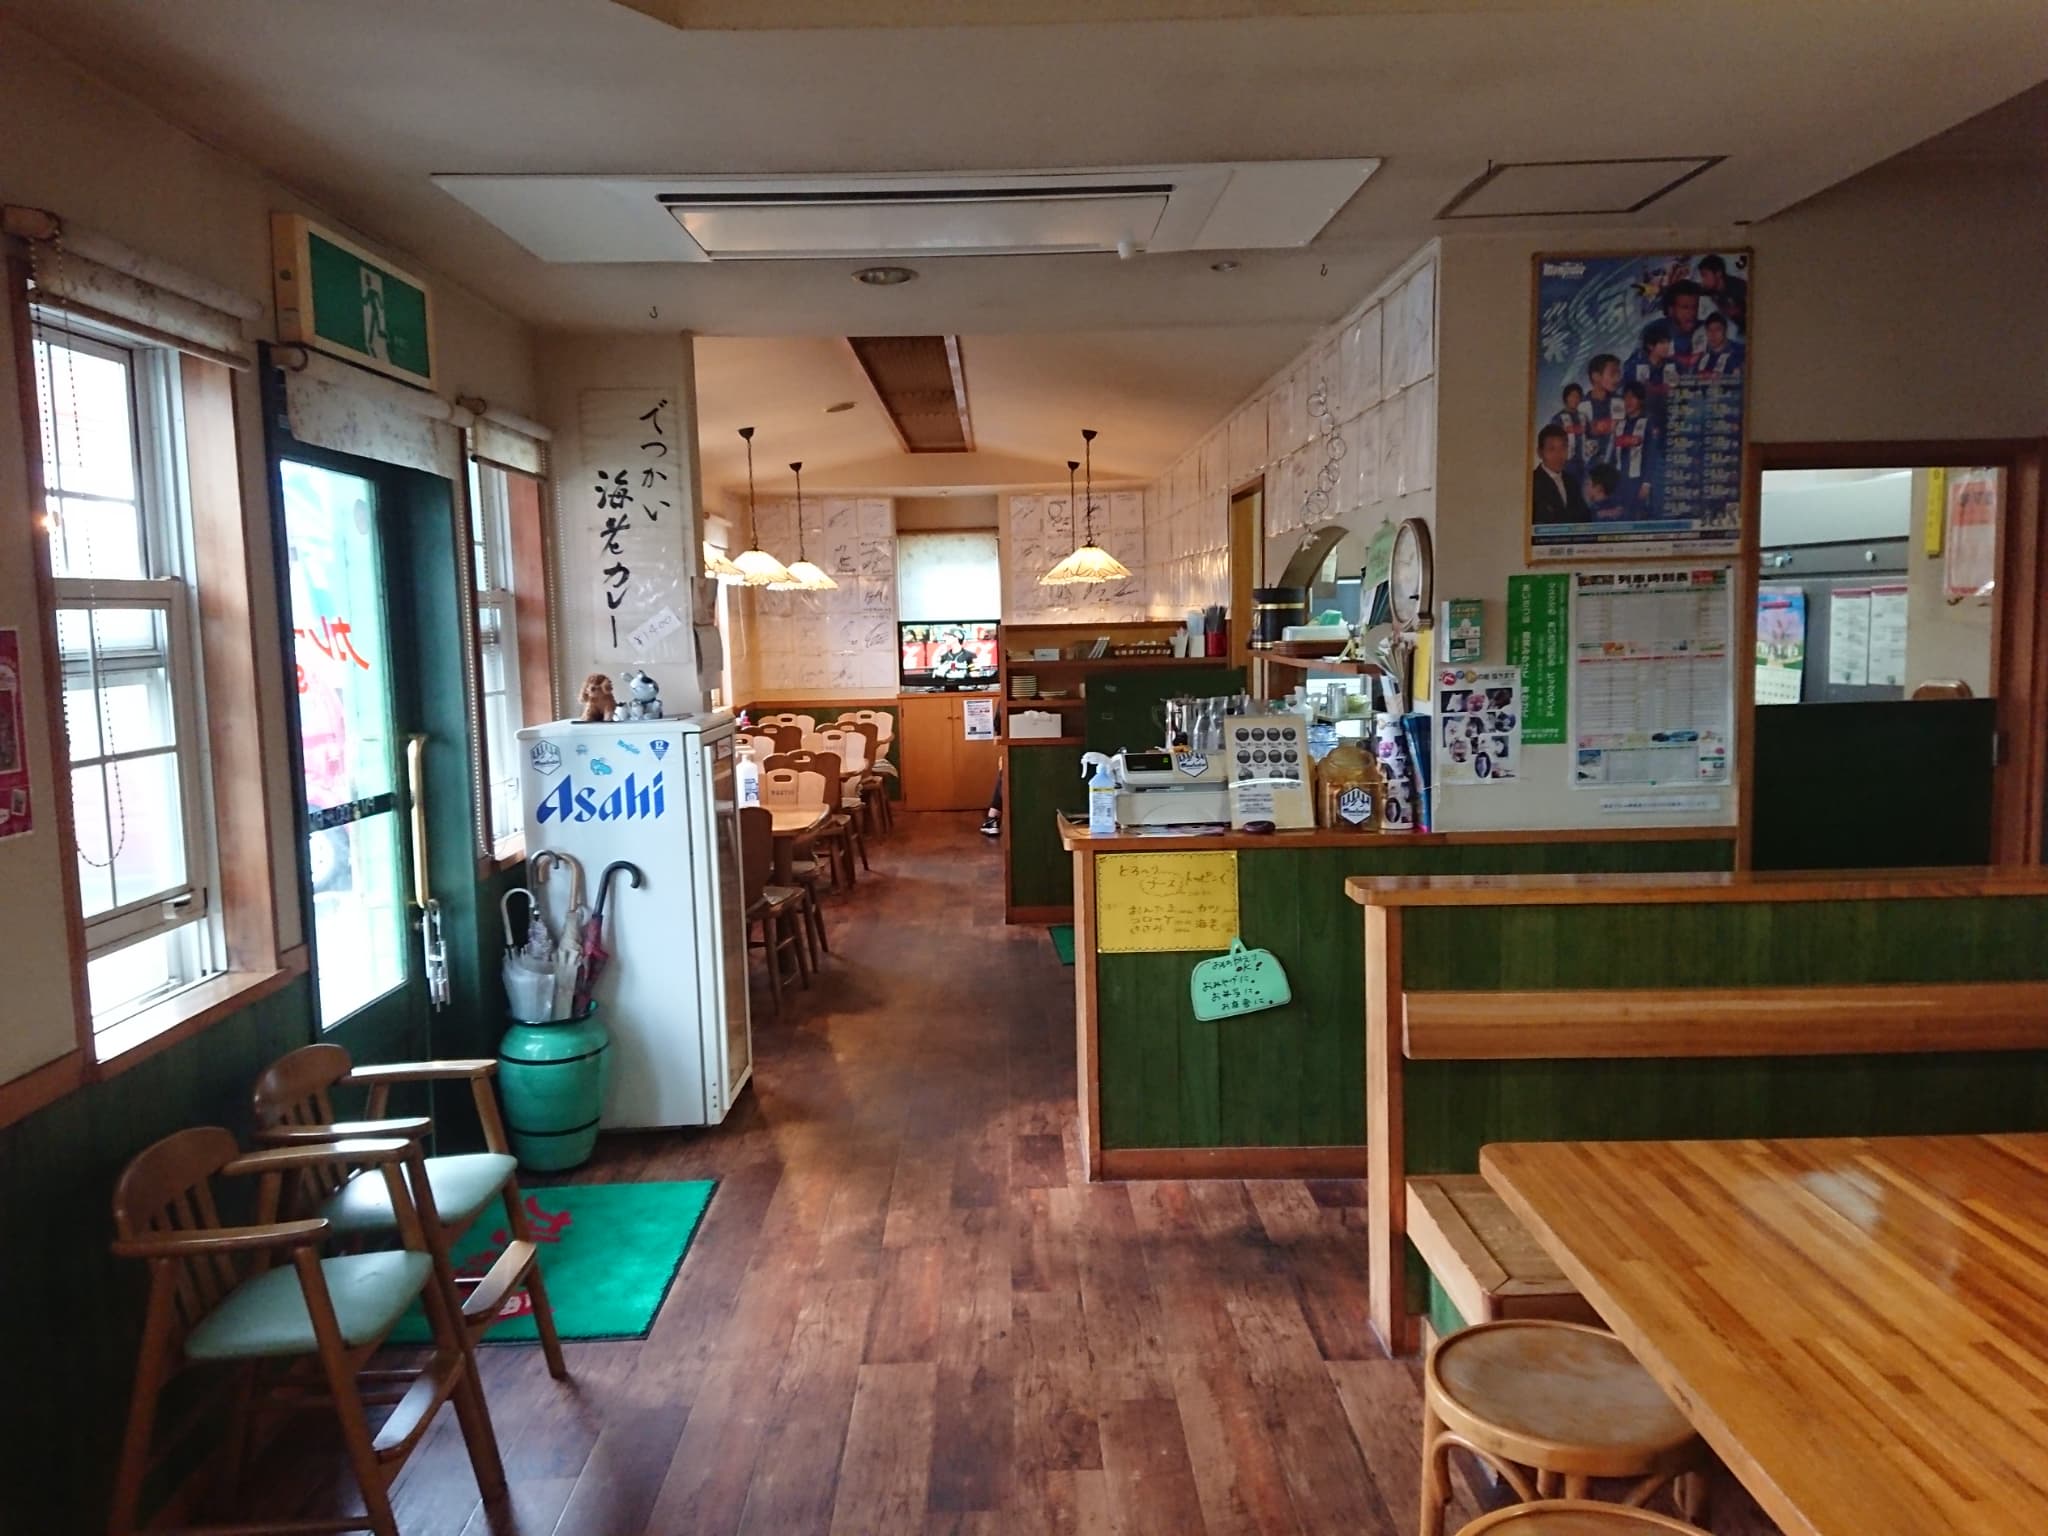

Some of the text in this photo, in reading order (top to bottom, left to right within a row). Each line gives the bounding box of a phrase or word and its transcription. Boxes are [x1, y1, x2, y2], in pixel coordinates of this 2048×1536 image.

[594, 469, 635, 649] 海老カレー
[536, 770, 666, 825] Asahi
